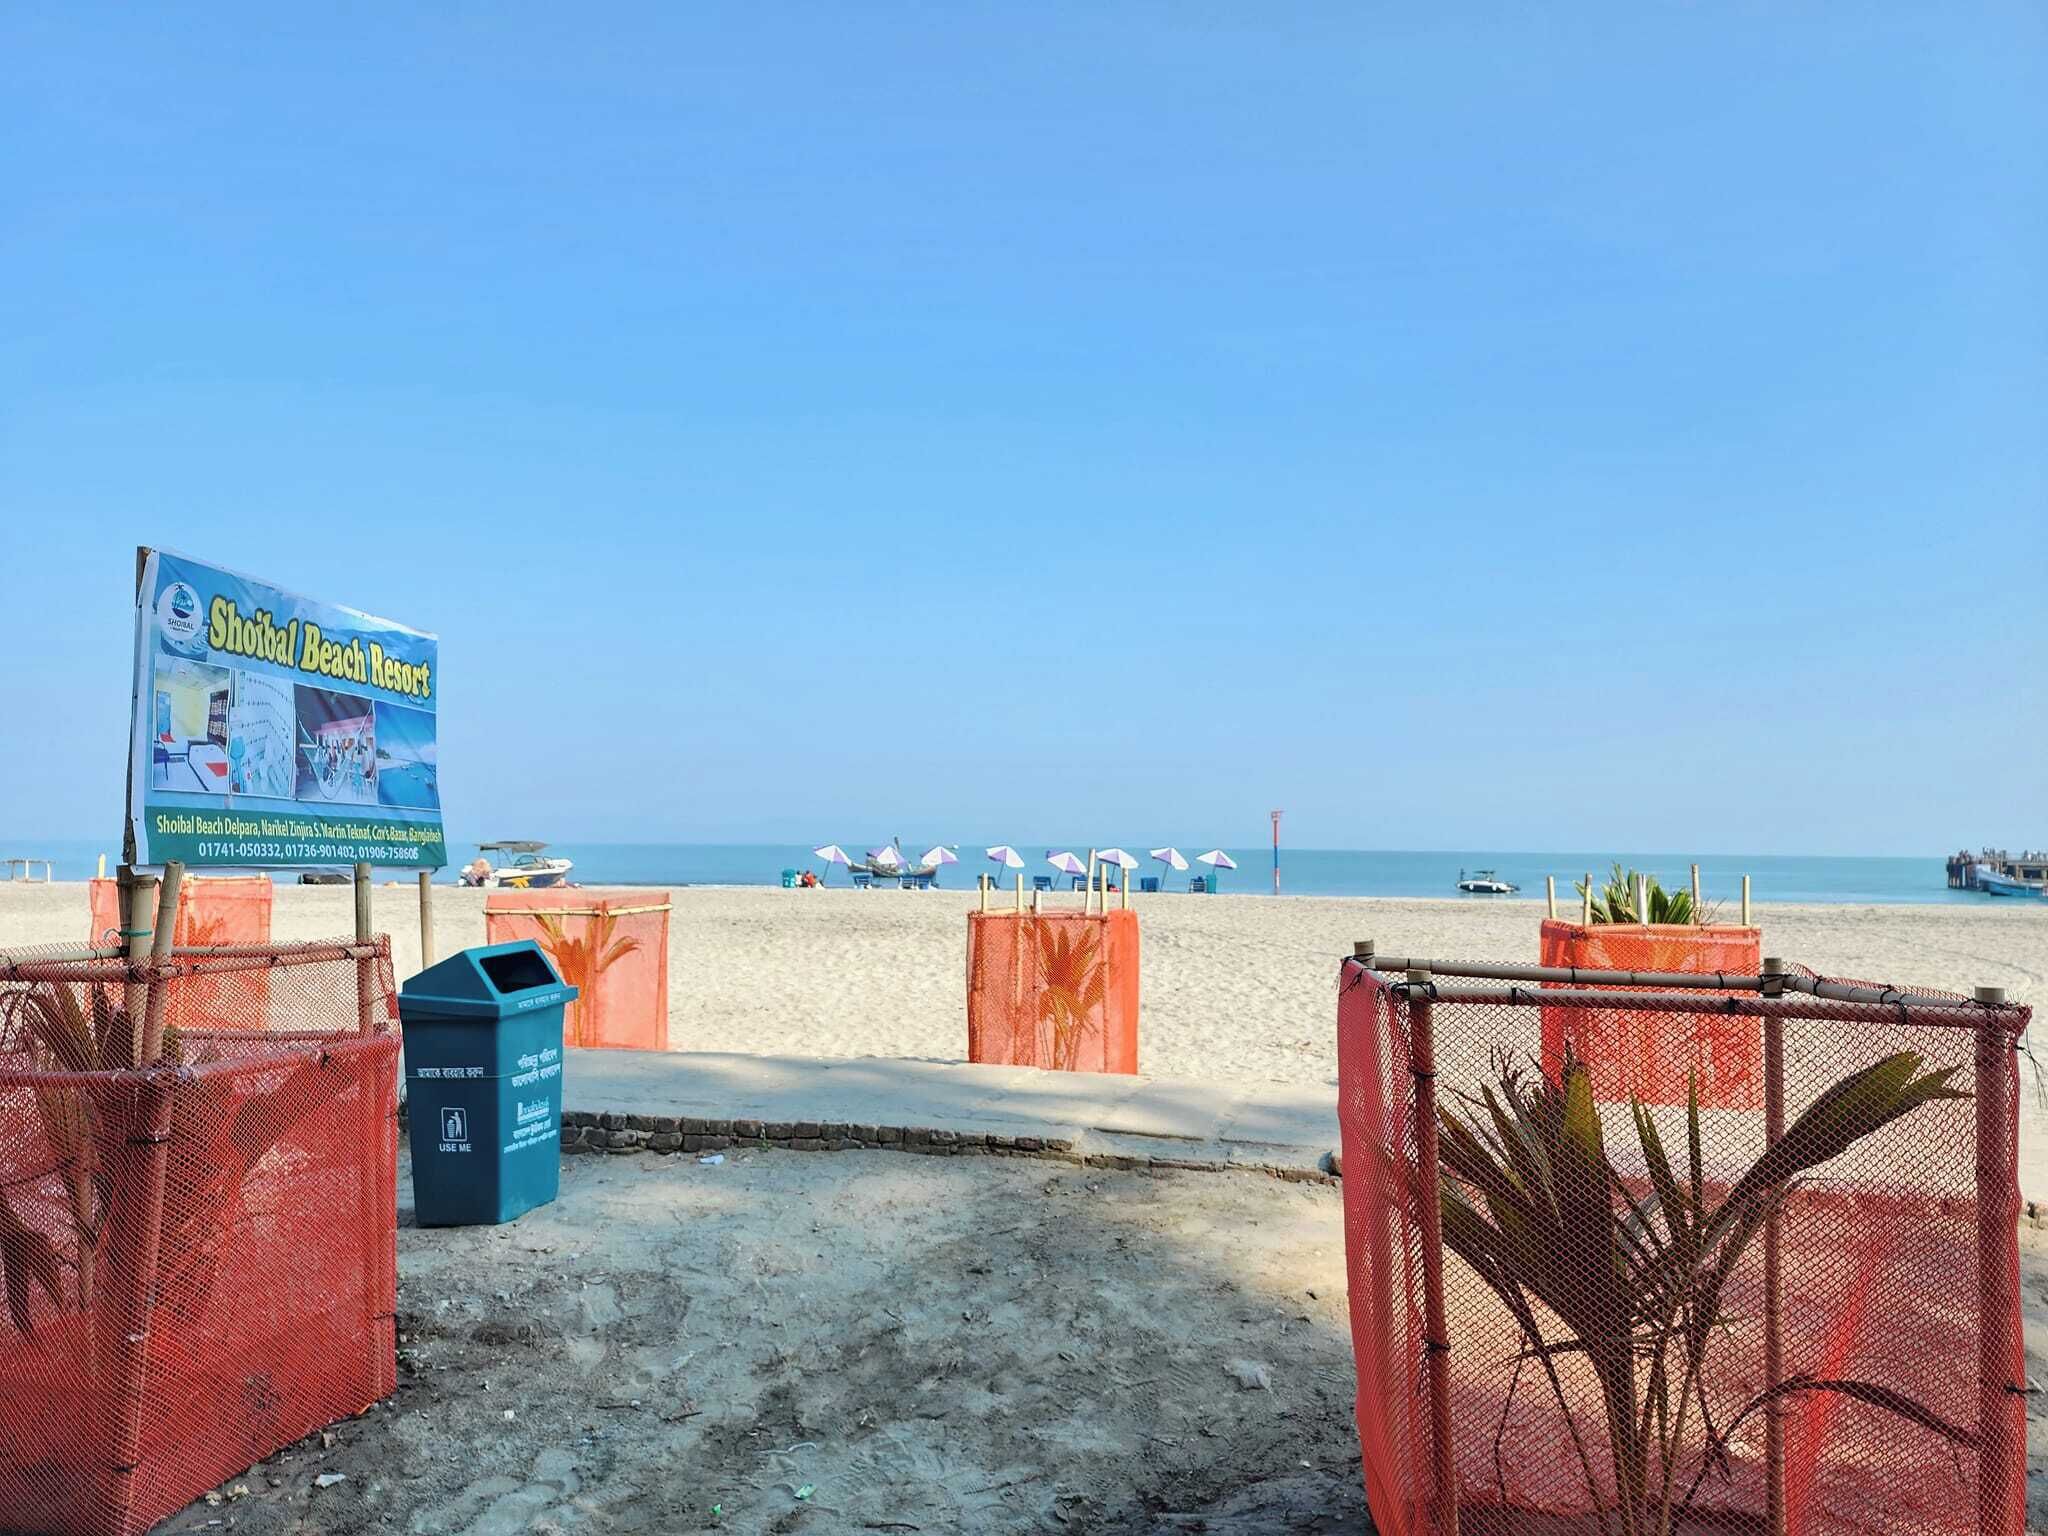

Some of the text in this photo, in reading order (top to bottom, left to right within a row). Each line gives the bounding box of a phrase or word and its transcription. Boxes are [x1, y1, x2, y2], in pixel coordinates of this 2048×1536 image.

[168, 618, 194, 631] SHOIBAL
[208, 595, 432, 699] Shoibal Beach Resort
[157, 815, 194, 834] Shoibal
[196, 816, 223, 835] Beach
[225, 817, 260, 840] Delpara,
[261, 819, 288, 836] Narikel
[289, 820, 313, 841] Zinjira
[313, 822, 321, 838] S.
[346, 824, 371, 842] Teknaf,
[372, 825, 390, 841] Cox's
[409, 827, 442, 846] Bangladesh
[199, 842, 419, 860] 01741-050332, 01736-901402, 01906-758606
[439, 1143, 472, 1153] USE ME
